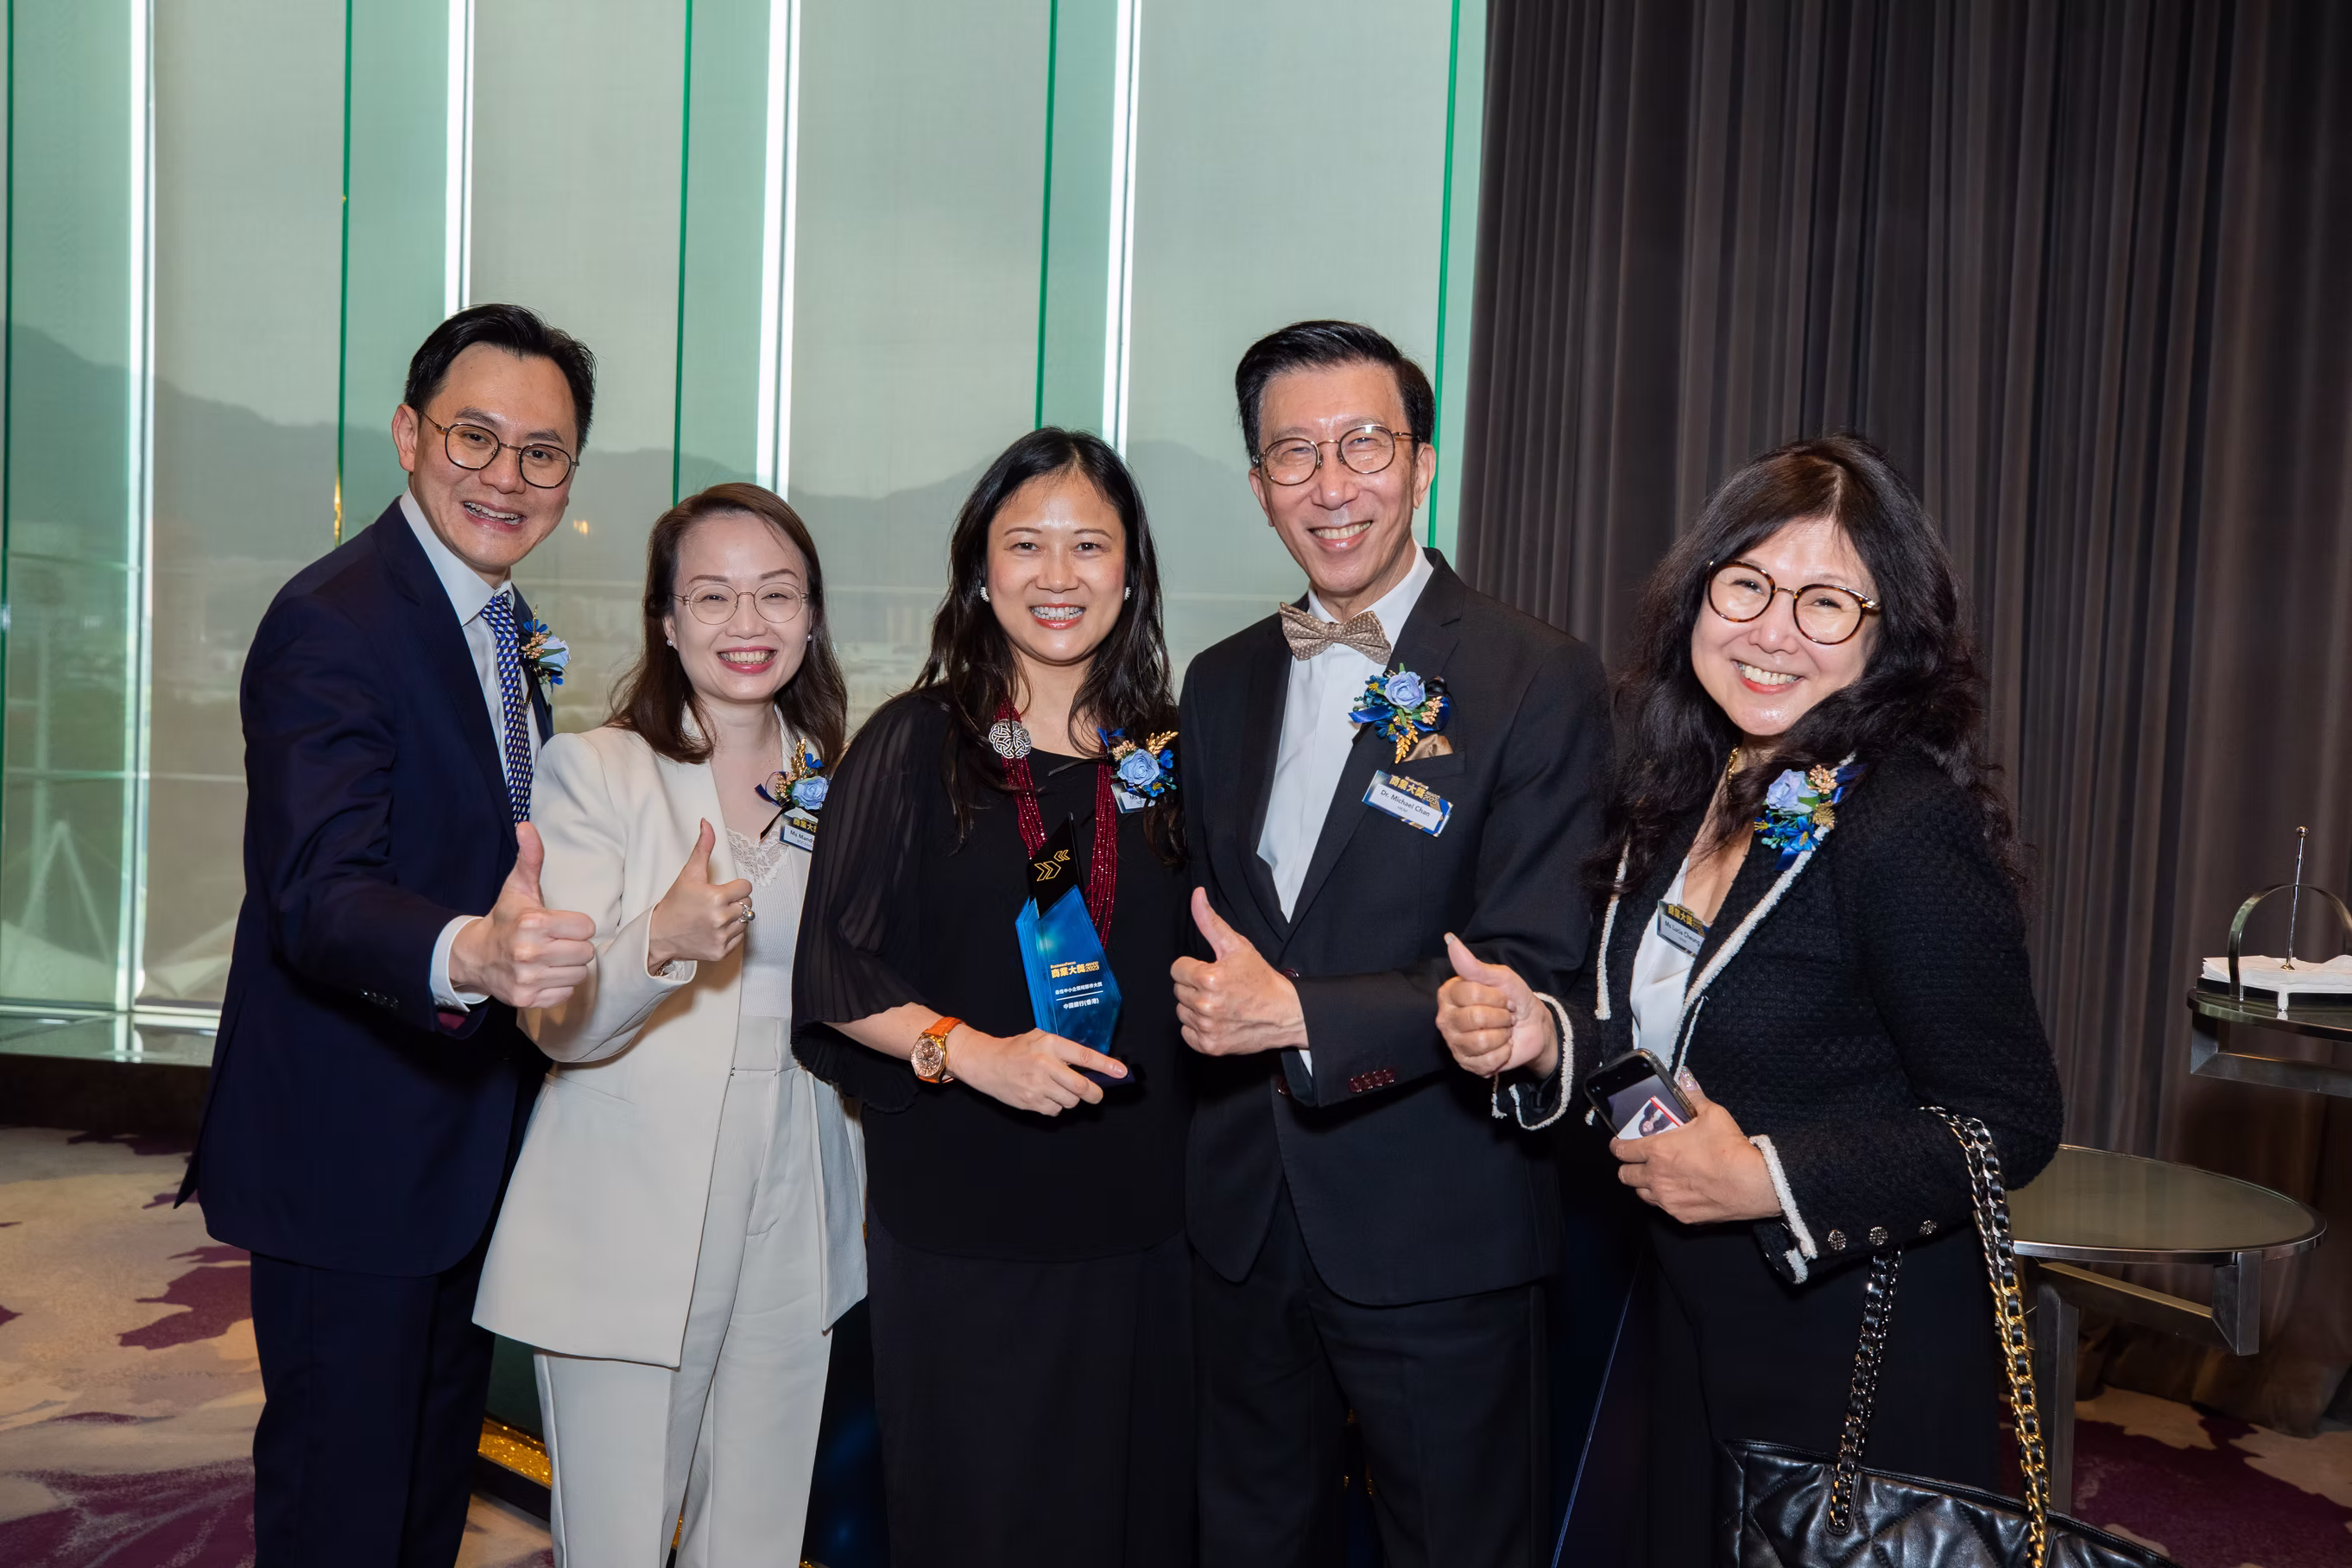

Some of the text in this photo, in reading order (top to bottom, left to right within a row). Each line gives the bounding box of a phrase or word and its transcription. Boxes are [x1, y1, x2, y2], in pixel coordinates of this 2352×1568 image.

[1381, 789, 1389, 798] Dr.
[1390, 794, 1415, 809] Michael
[1415, 806, 1431, 817] Chan
[1665, 920, 1672, 929] Ms
[1051, 964, 1085, 978] 商業大獎
